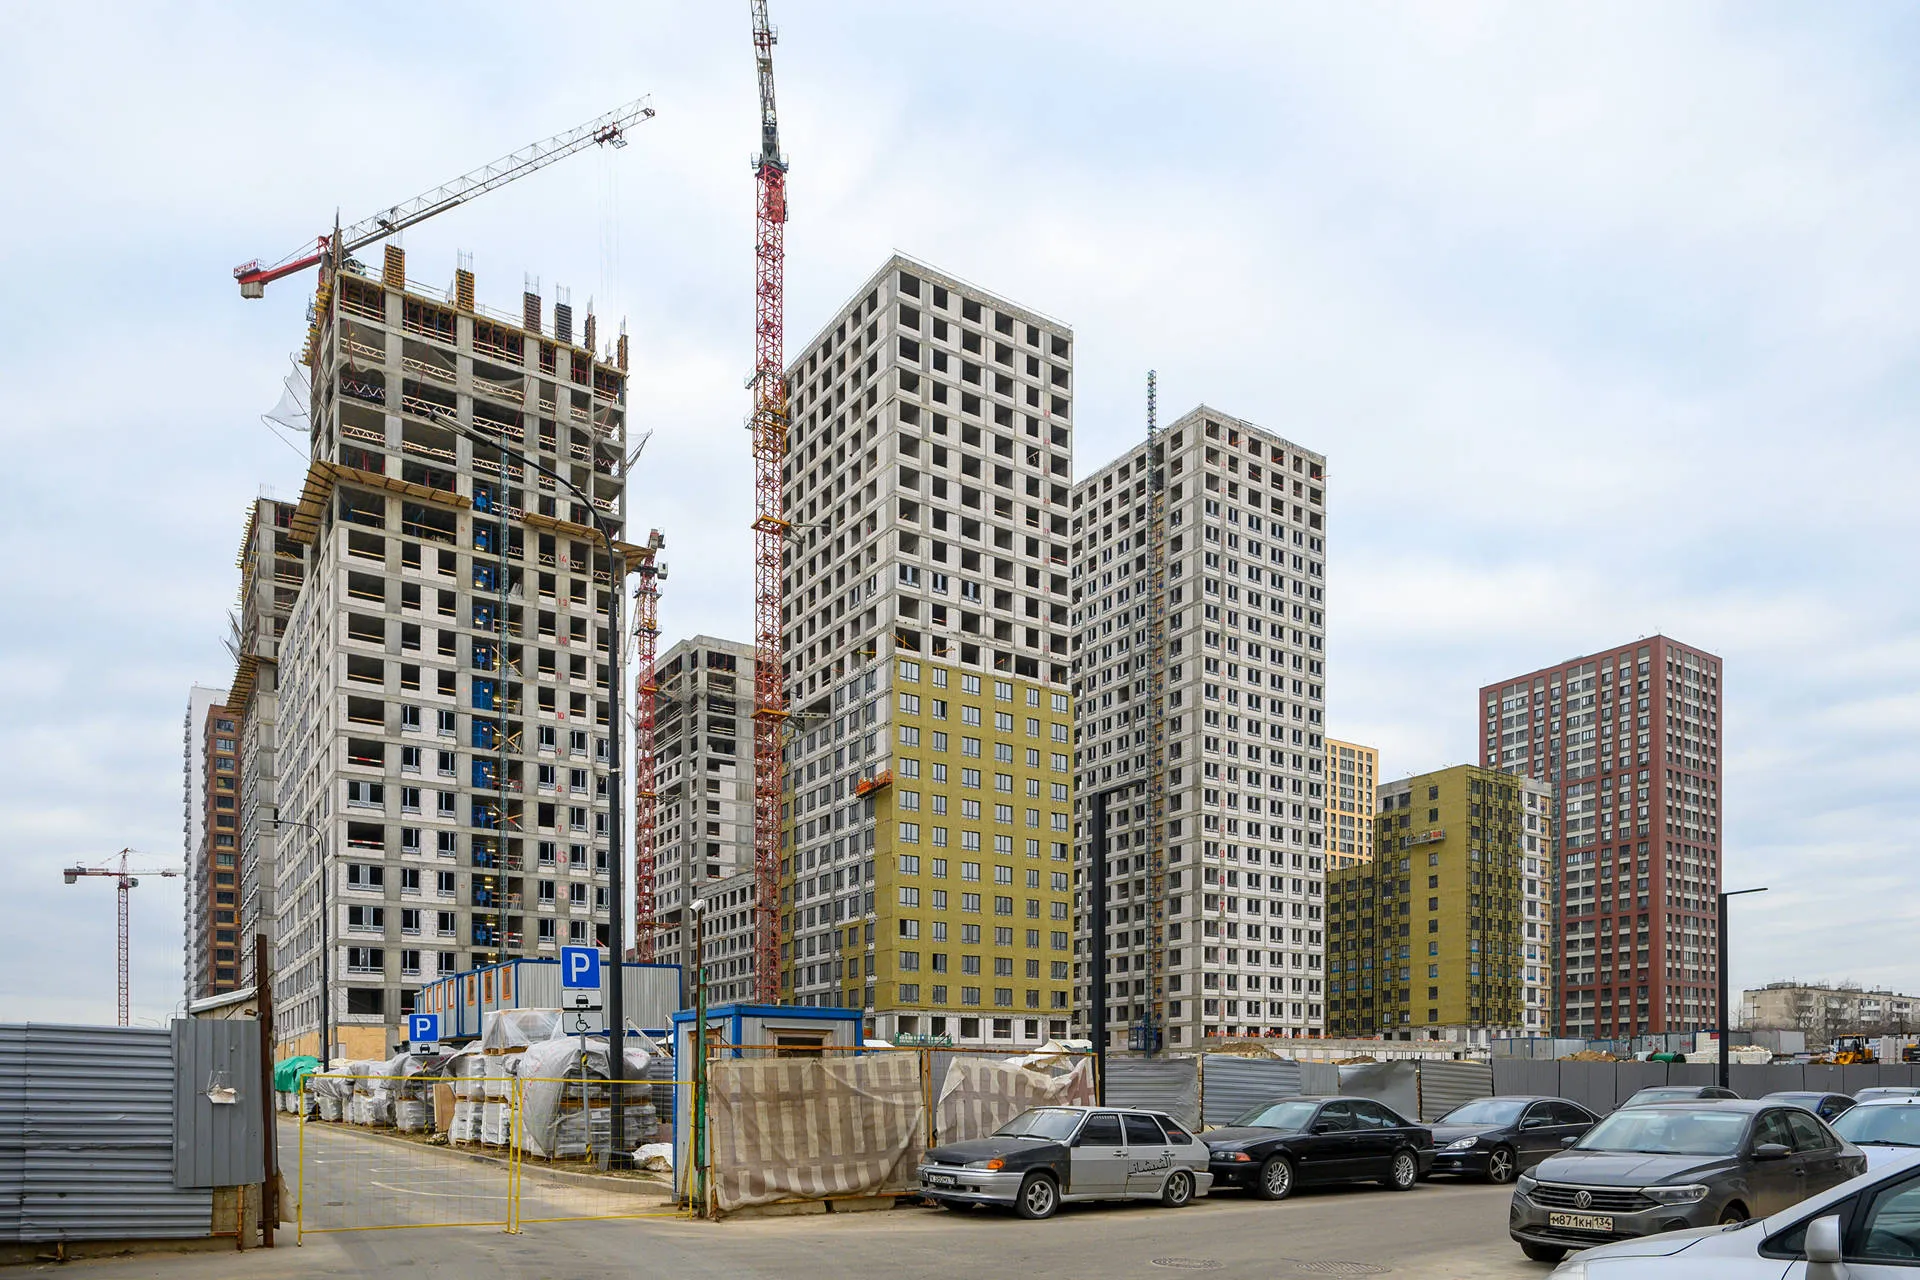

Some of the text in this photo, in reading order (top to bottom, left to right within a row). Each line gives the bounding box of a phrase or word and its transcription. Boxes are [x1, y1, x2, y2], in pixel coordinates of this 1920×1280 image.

[558, 553, 567, 564] 14
[557, 597, 568, 608] 13
[556, 672, 563, 680] 11
[557, 711, 565, 720] 10
[557, 747, 562, 756] 9
[556, 784, 563, 793] 8
[557, 824, 563, 833] 7
[557, 850, 568, 864] 6
[1219, 849, 1225, 858] 9
[1219, 875, 1225, 885] 8
[557, 885, 569, 900] 5
[1219, 901, 1225, 912] 7
[556, 924, 568, 937] 4
[570, 952, 590, 983] P
[416, 1017, 431, 1039] P
[1594, 1216, 1612, 1227] 134
